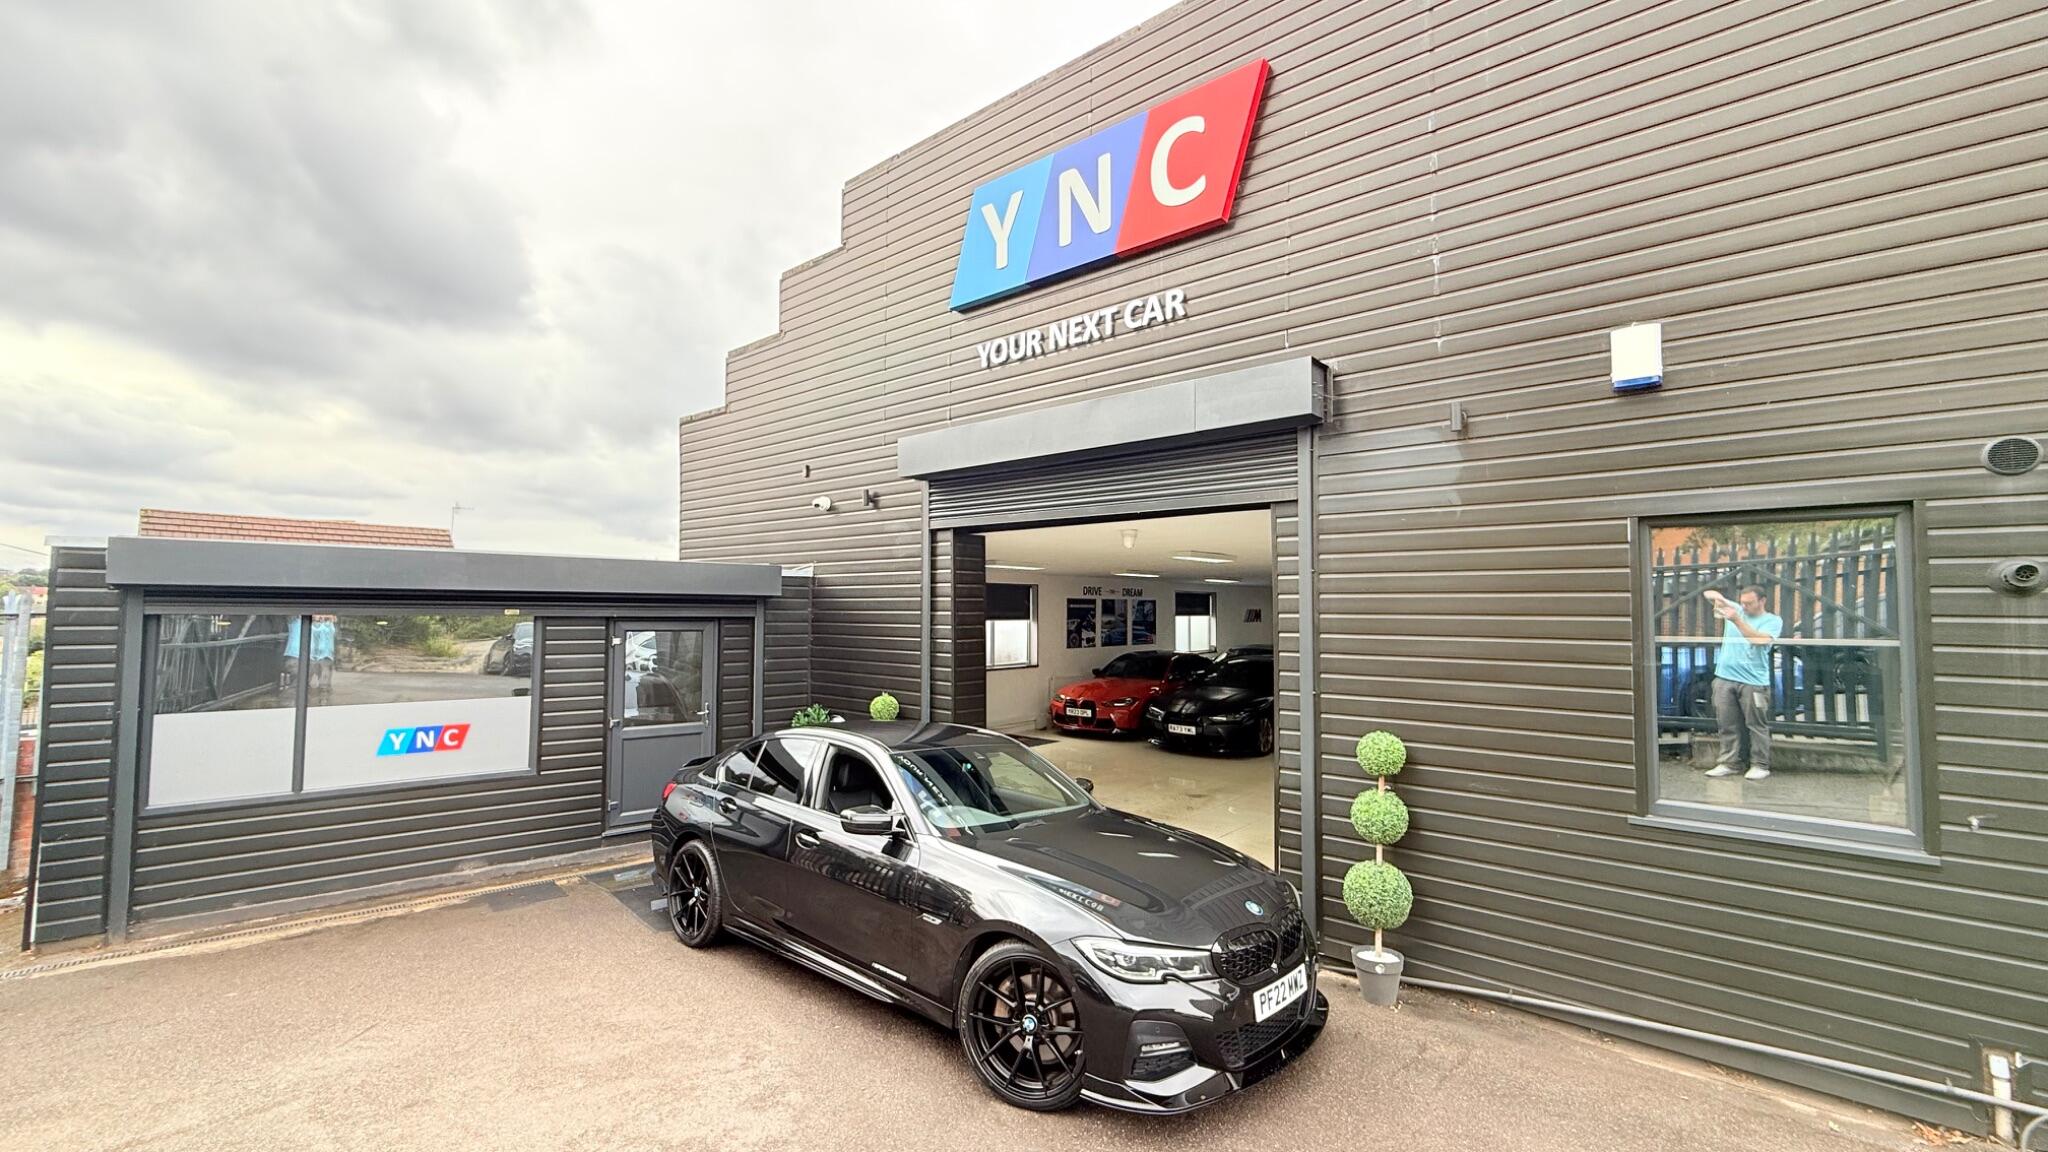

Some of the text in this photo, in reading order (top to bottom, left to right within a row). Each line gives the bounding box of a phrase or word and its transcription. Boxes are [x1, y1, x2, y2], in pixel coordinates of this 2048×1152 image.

[981, 115, 1206, 269] YNC
[976, 288, 1186, 368] YOUR NEXT CAR
[1083, 586, 1102, 596] DRIVE
[1122, 588, 1143, 597] DREAM
[389, 729, 459, 751] YNC
[1260, 969, 1304, 1015] PF22 MWZ
